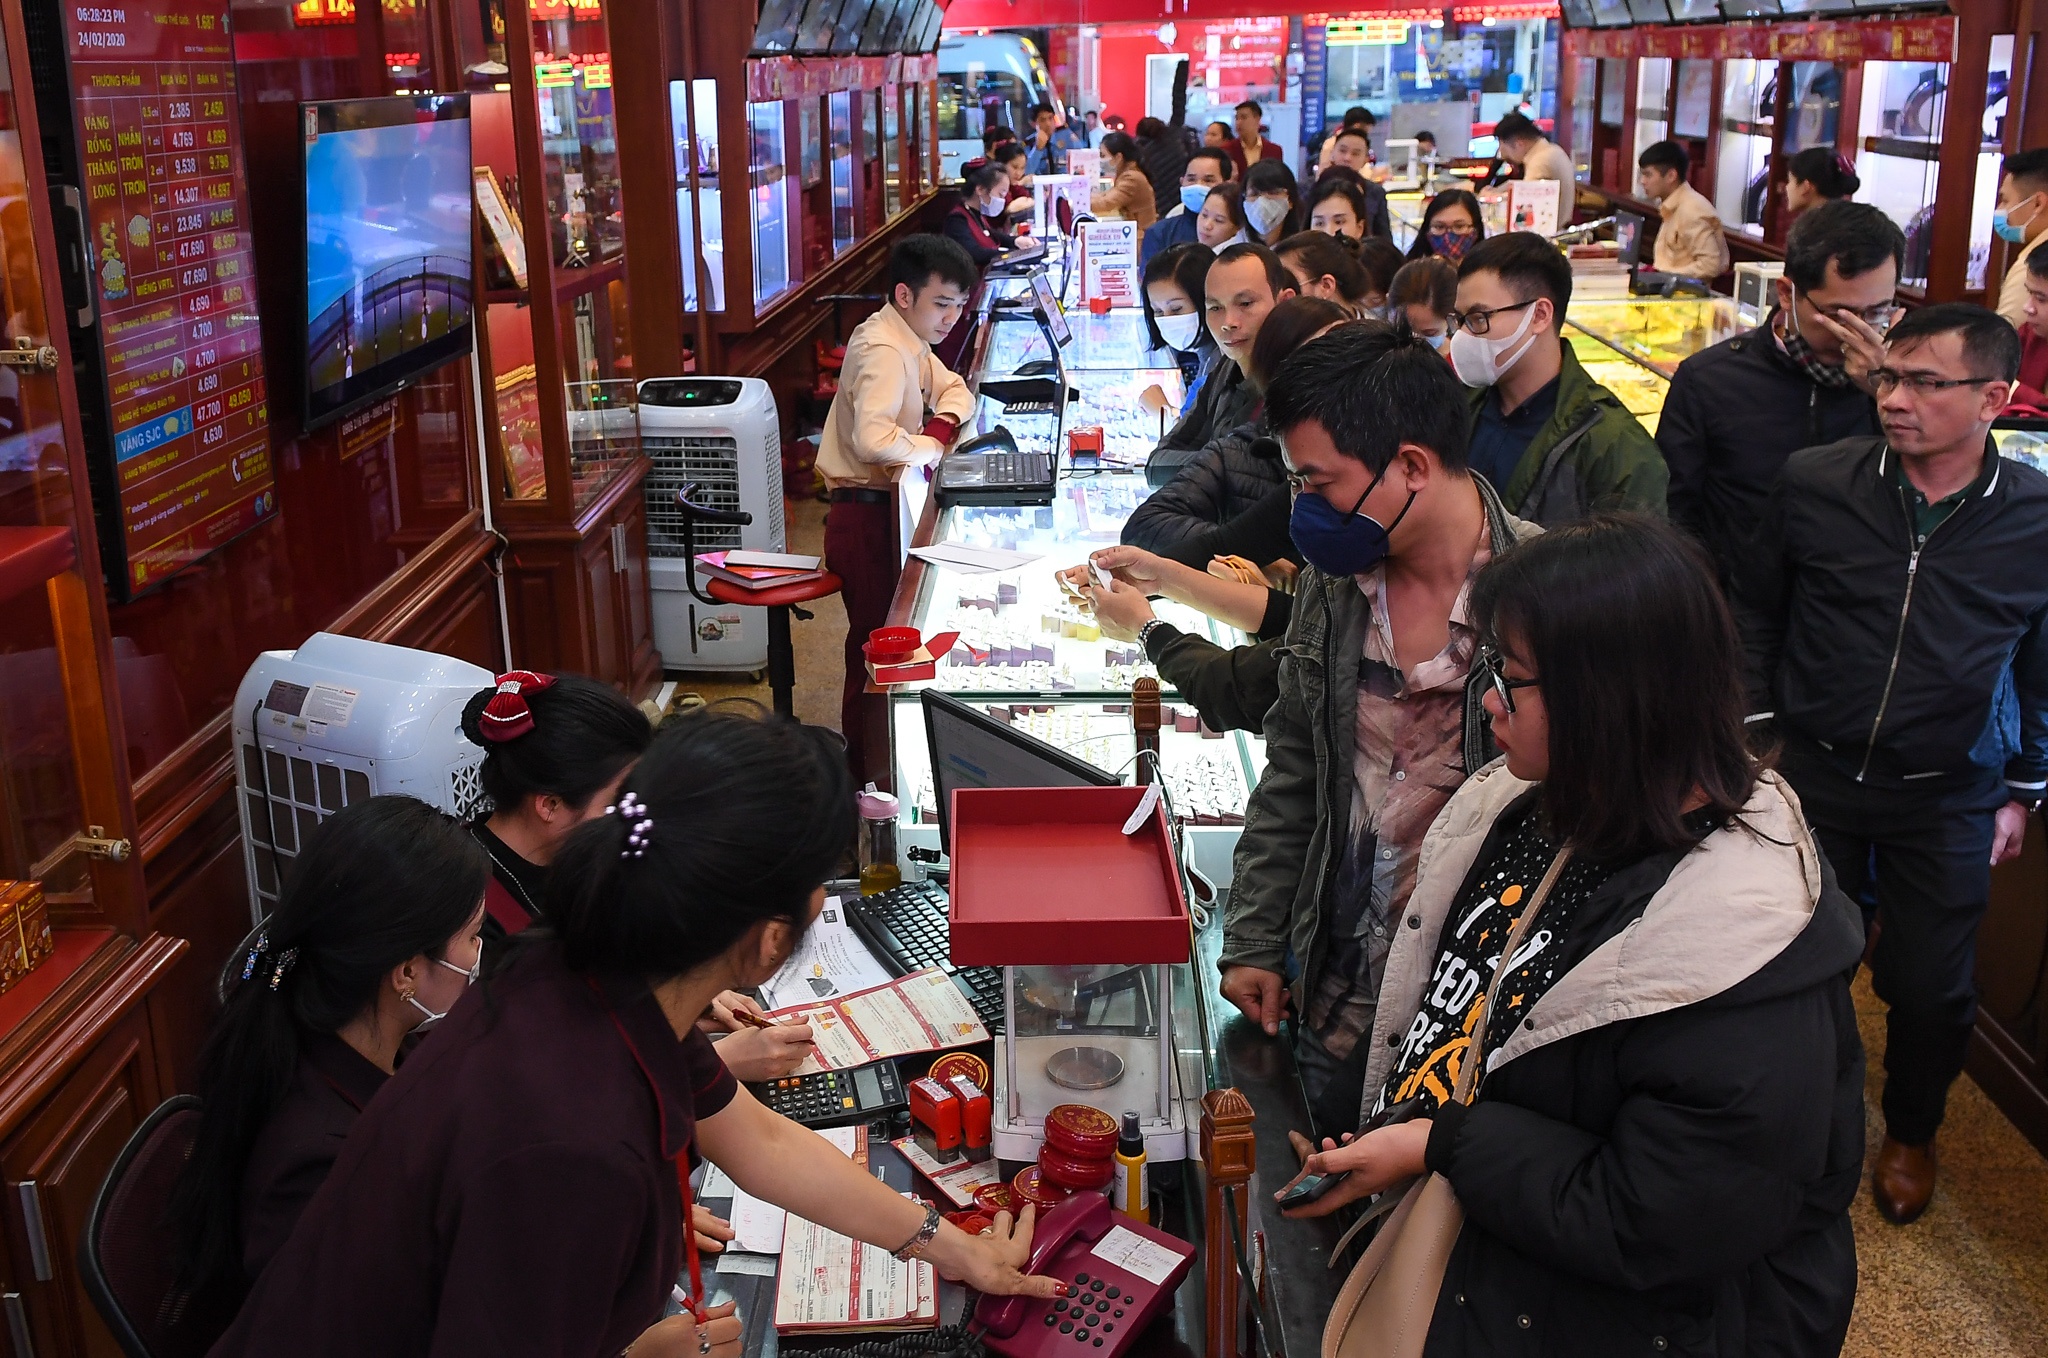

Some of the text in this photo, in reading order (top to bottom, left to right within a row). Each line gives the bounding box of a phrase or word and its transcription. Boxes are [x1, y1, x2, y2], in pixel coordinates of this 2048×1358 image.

[76, 7, 126, 22] 06:28:23 PM
[78, 32, 126, 48] 24/02/2020
[169, 102, 191, 118] 2.385
[84, 112, 110, 130] VÀNG
[86, 132, 112, 154] RỒNG
[172, 132, 194, 148] 4.769
[151, 165, 155, 176] 2
[174, 158, 196, 174] 9.538
[92, 184, 116, 199] LONG
[174, 187, 199, 204] 14.307
[156, 223, 161, 234] 5
[177, 214, 203, 233] 23.845
[180, 240, 205, 259] 47.690
[183, 267, 208, 286] 47.690
[189, 294, 210, 313] 4.690
[192, 321, 212, 340] 4.700
[195, 350, 215, 368] 4.700
[242, 362, 248, 376] 0
[198, 374, 218, 393] 4.690
[197, 400, 221, 422] 47.700
[248, 412, 253, 425] 0
[120, 426, 161, 453] VÀNG SJC
[203, 425, 223, 445] 4.630
